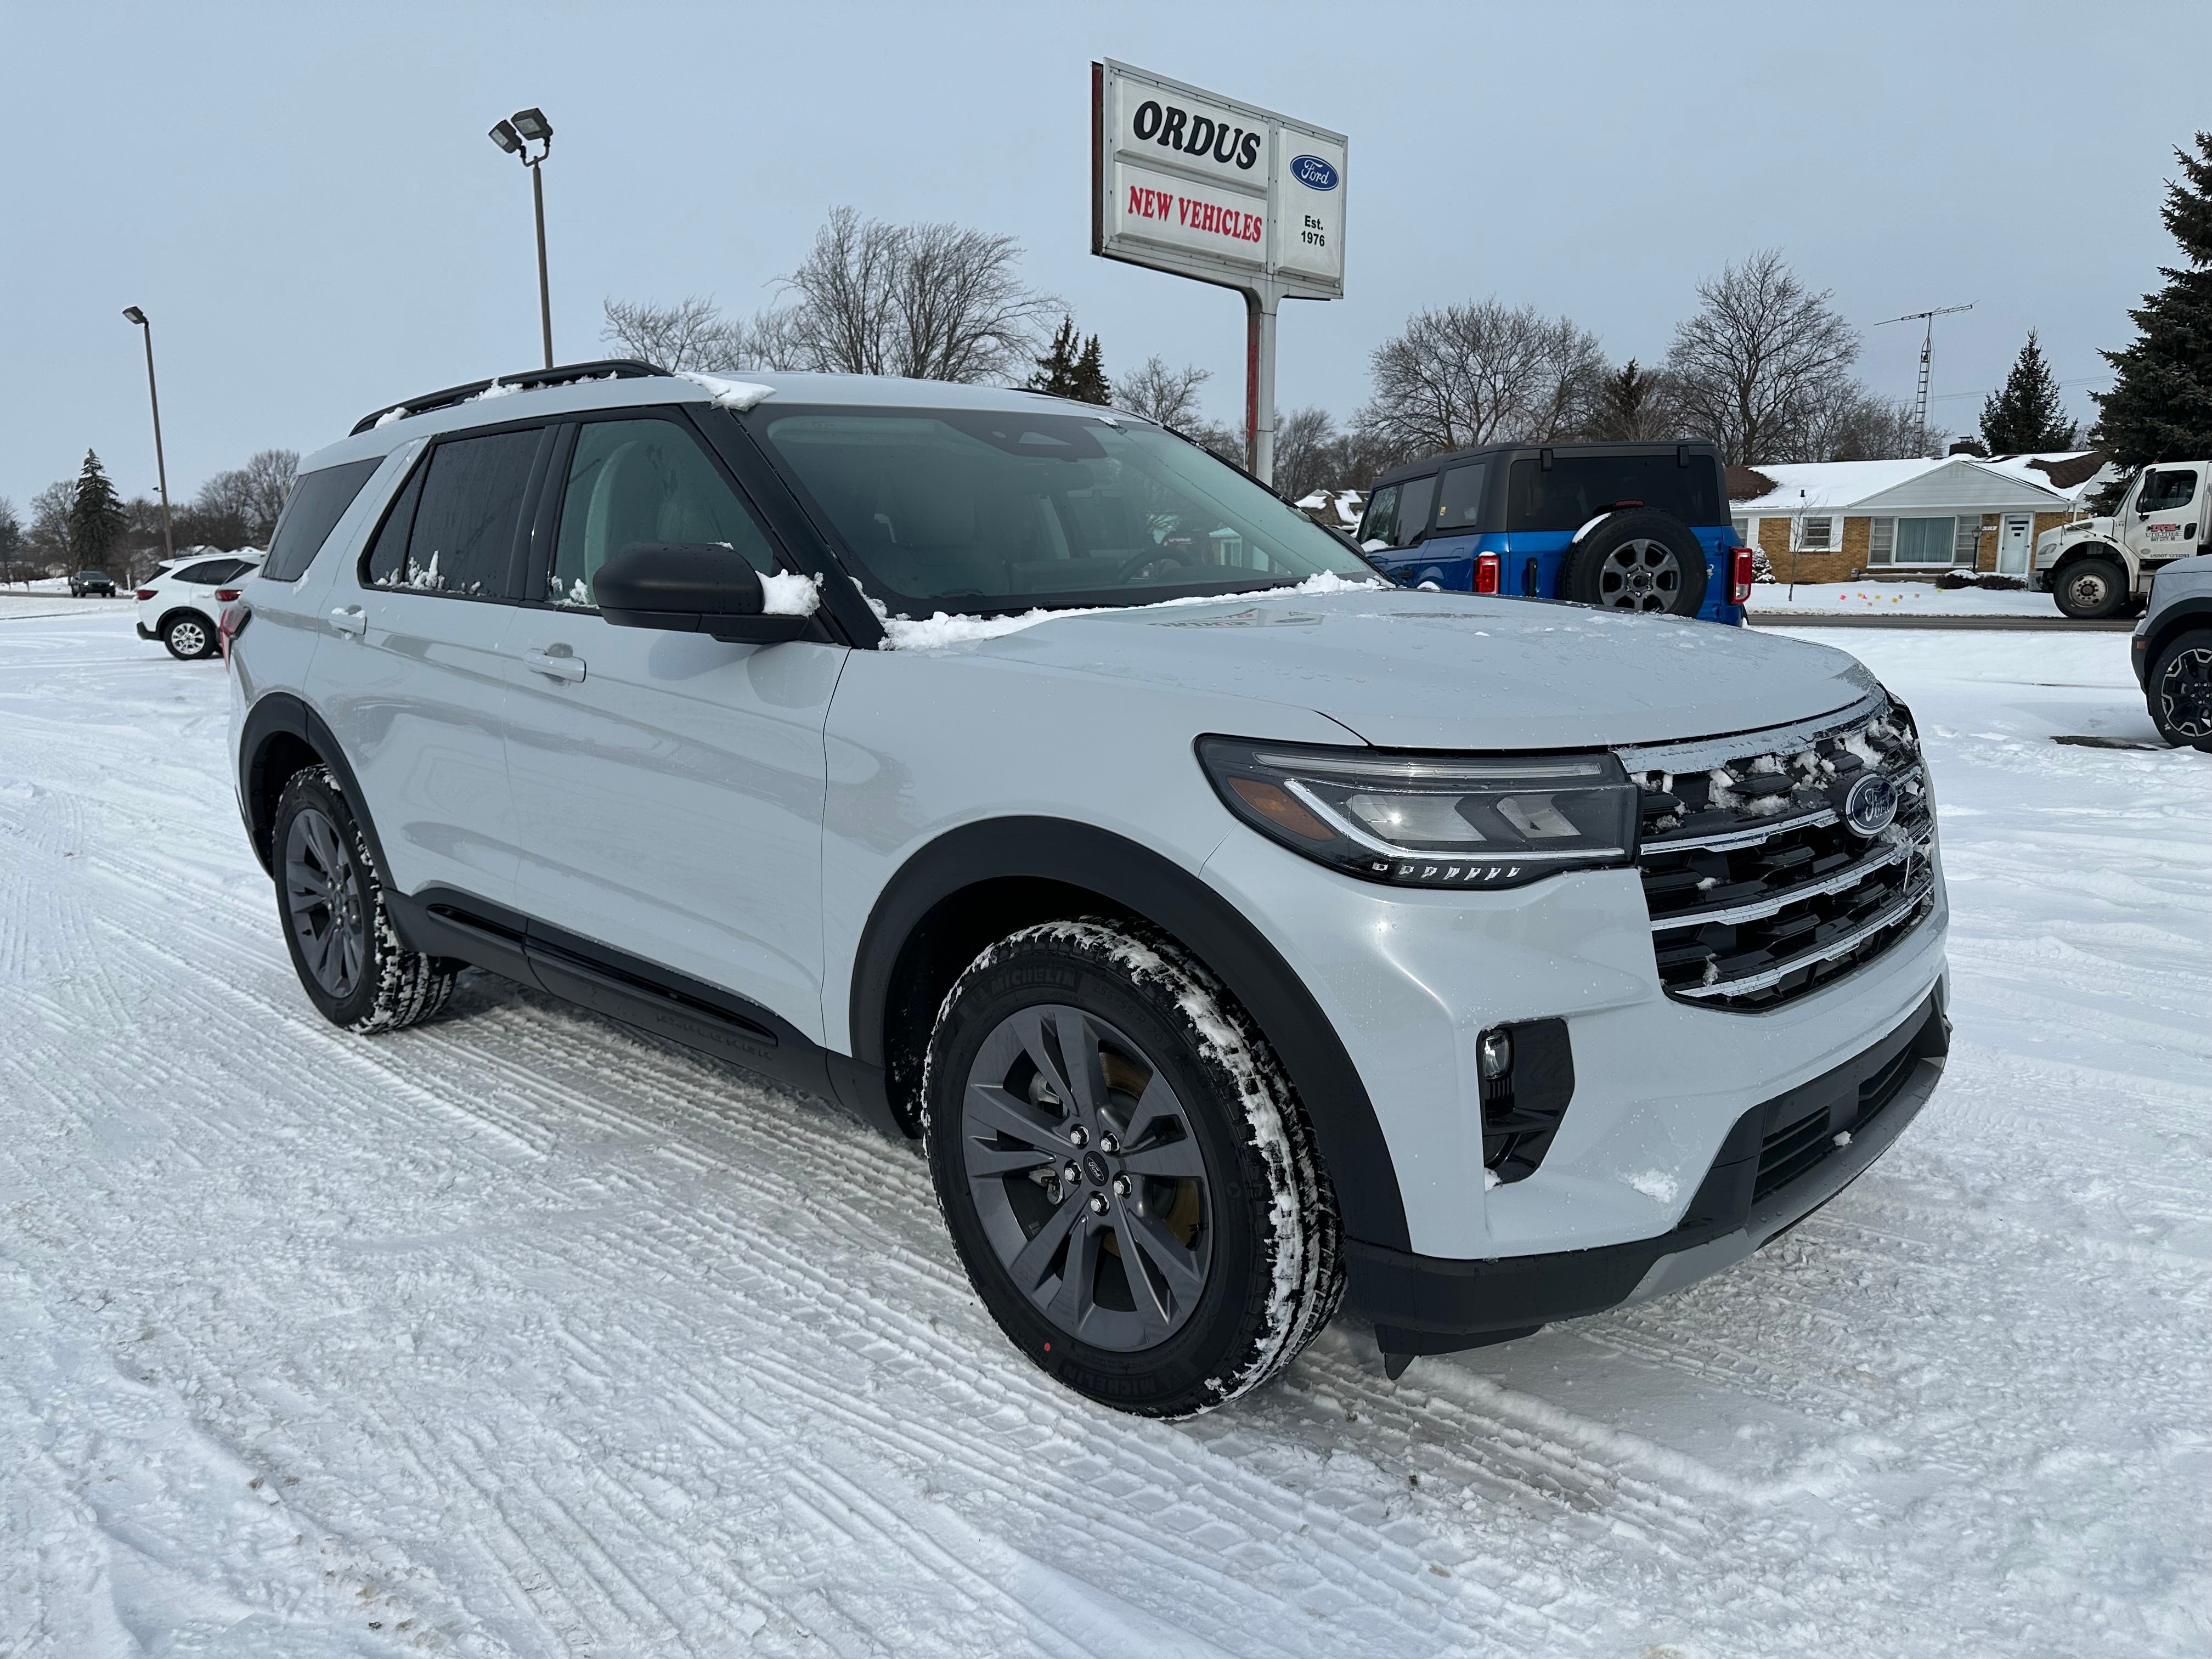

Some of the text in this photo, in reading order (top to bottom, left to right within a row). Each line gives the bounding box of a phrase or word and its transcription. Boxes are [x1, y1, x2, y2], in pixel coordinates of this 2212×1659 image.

[1133, 100, 1261, 170] ORDUS
[1301, 160, 1330, 185] Ford
[1128, 185, 1263, 243] NEW VEHICLES
[1305, 215, 1323, 230] Est.
[1301, 230, 1325, 247] 1976
[1865, 786, 1891, 822] Ford
[990, 968, 1076, 995] MICHELIN
[1092, 983, 1136, 1014] 255/55
[1136, 1014, 1147, 1025] R
[1147, 1025, 1164, 1042] 20
[656, 1013, 773, 1060] EXPLORER
[1088, 1161, 1101, 1177] Ford
[1003, 1318, 1049, 1363] PRIMACY
[1062, 1364, 1158, 1396] MICHELIN
